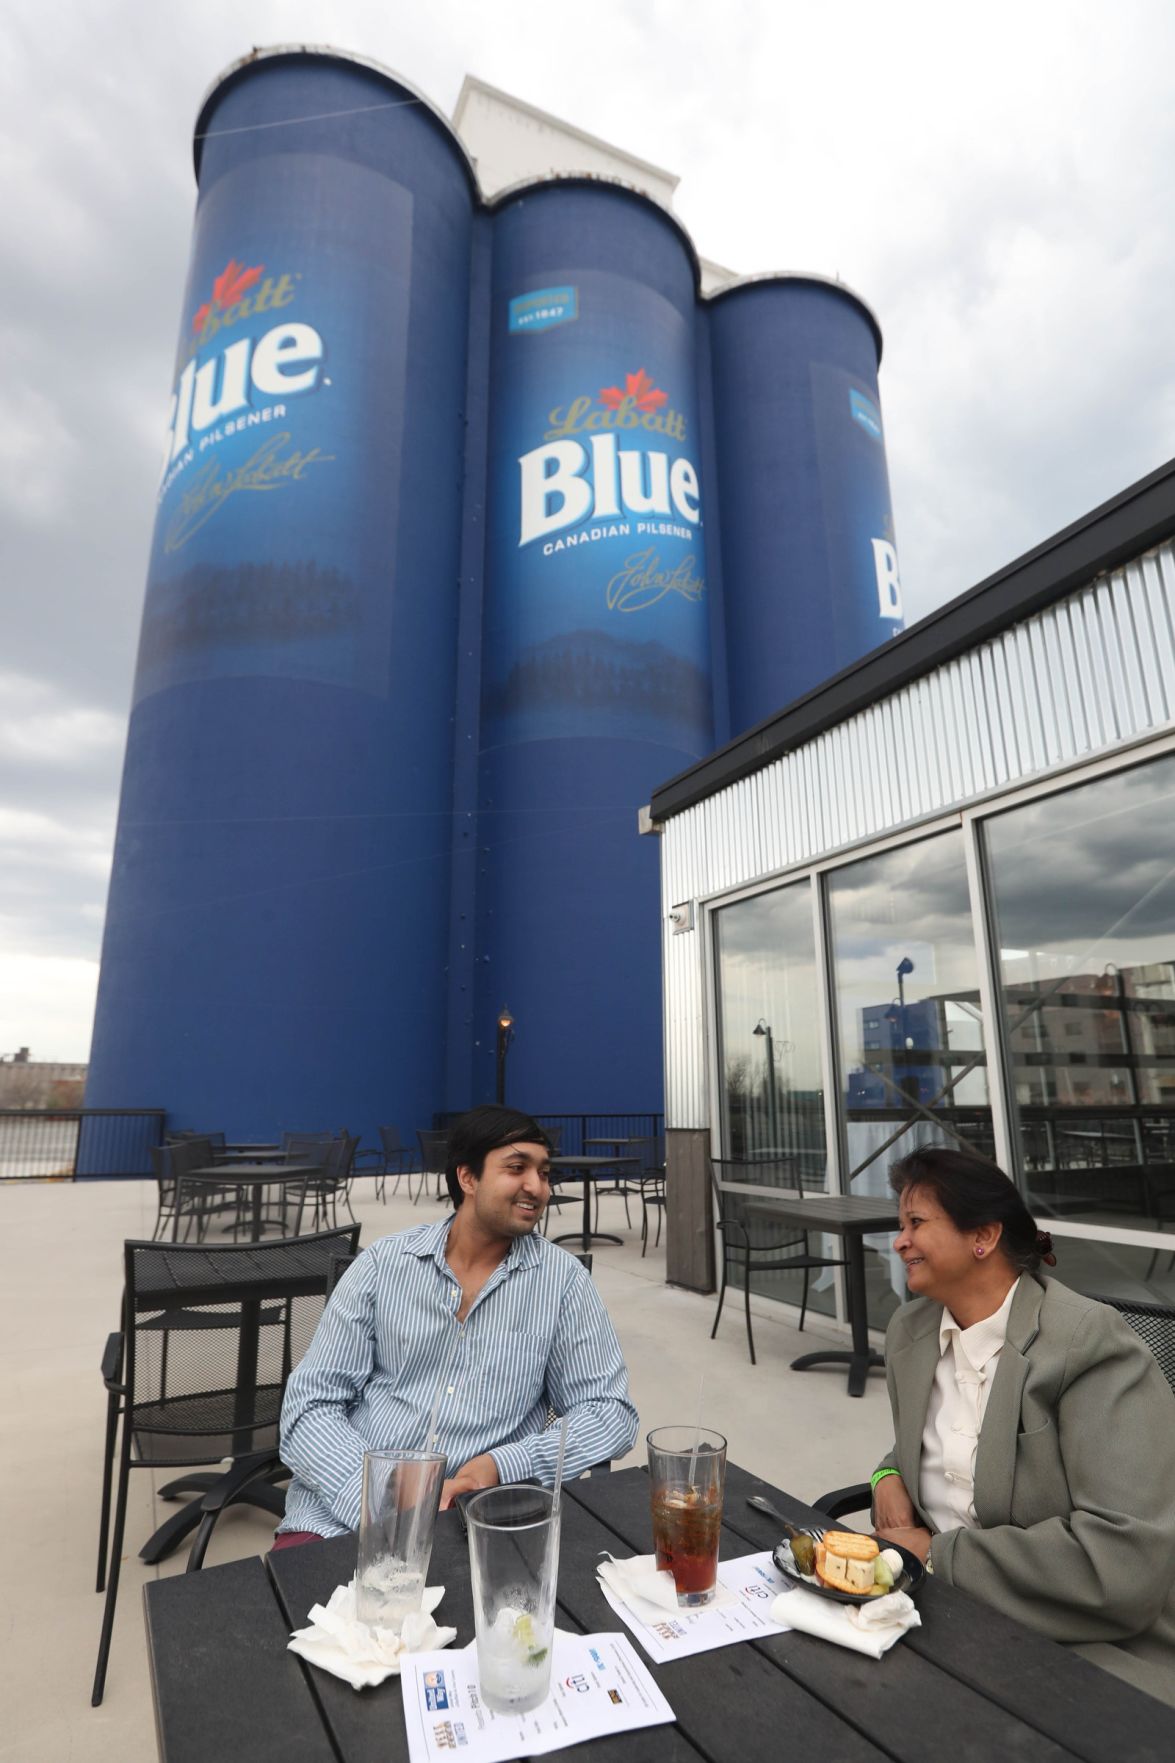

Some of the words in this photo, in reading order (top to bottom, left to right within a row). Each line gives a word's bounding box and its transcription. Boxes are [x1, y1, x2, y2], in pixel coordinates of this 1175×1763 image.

[162, 323, 322, 482] lue
[544, 396, 686, 441] Labatt
[199, 403, 287, 452] PILSENER
[518, 432, 701, 547] Blue
[543, 522, 630, 556] CANADIAN
[637, 522, 692, 541] PILSENER
